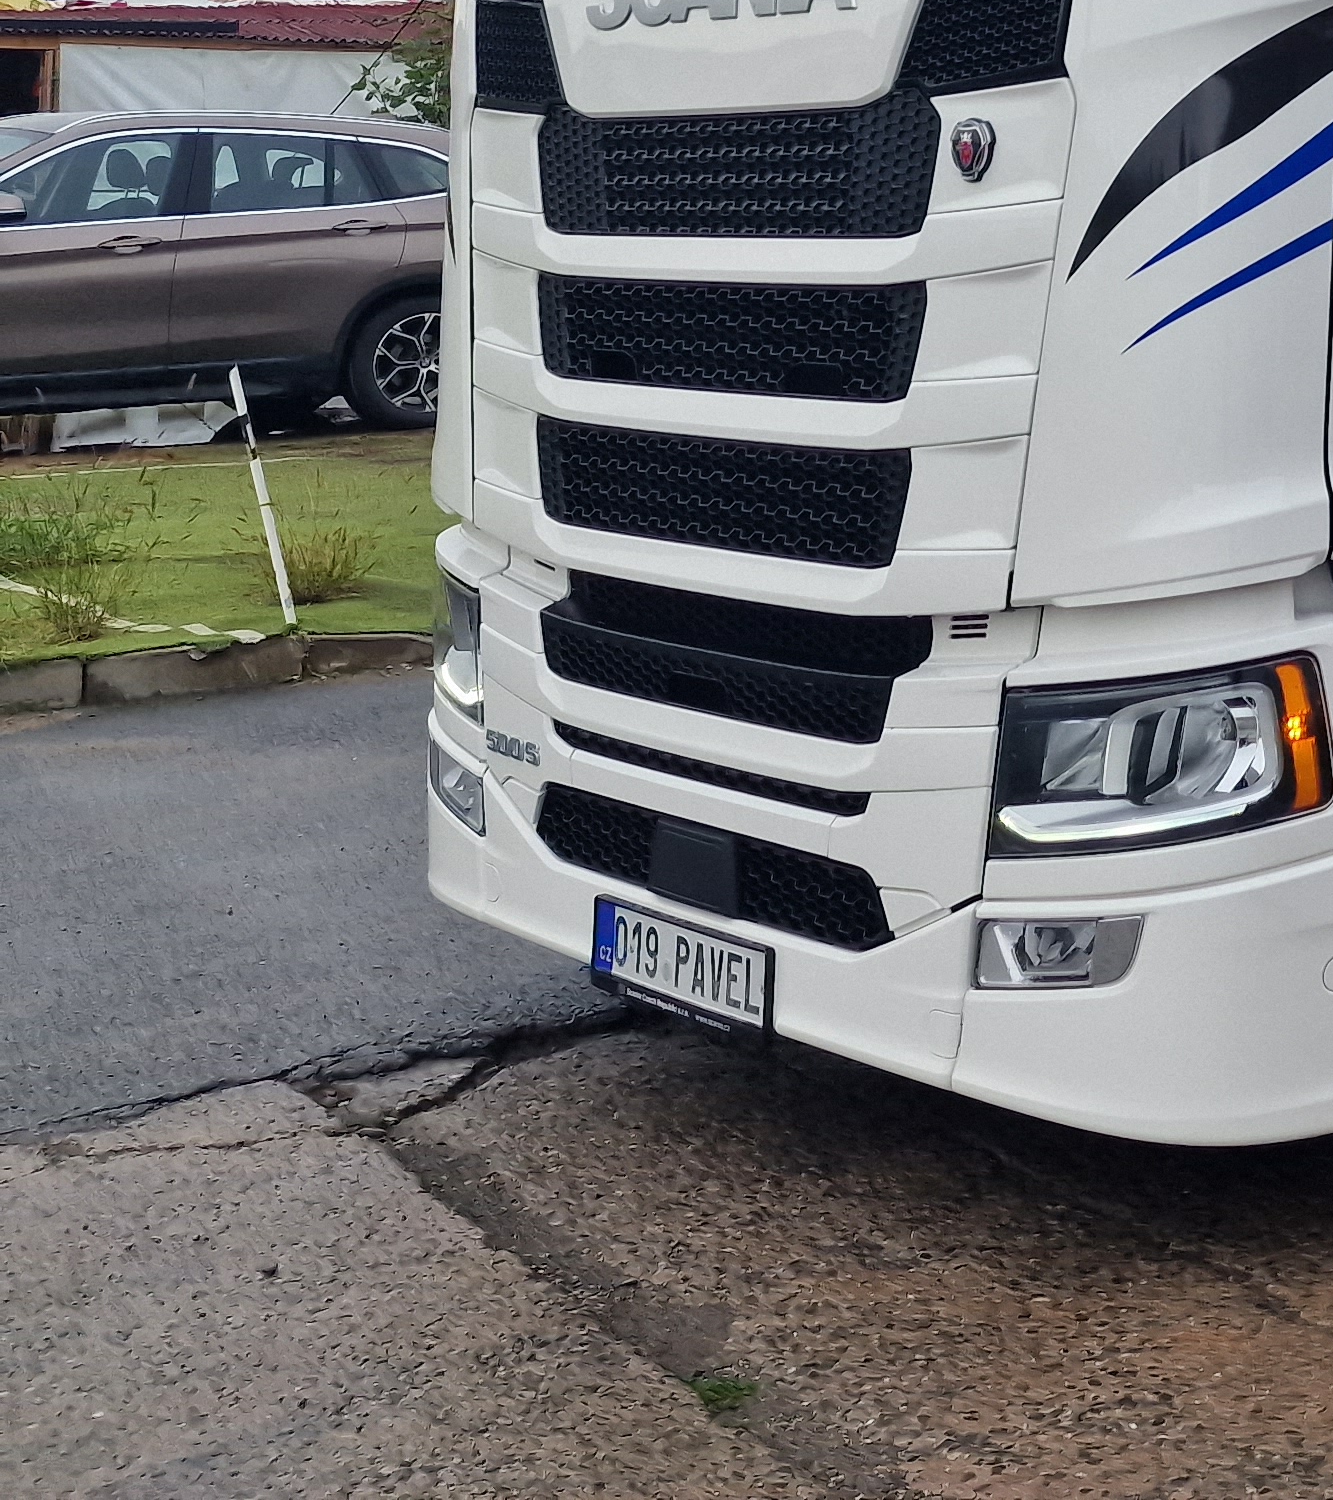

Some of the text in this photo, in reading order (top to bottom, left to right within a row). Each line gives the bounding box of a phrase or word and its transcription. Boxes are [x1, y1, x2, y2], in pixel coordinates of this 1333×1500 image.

[486, 729, 540, 767] 500S
[599, 945, 612, 963] CZ
[674, 934, 760, 1016] PAVEL
